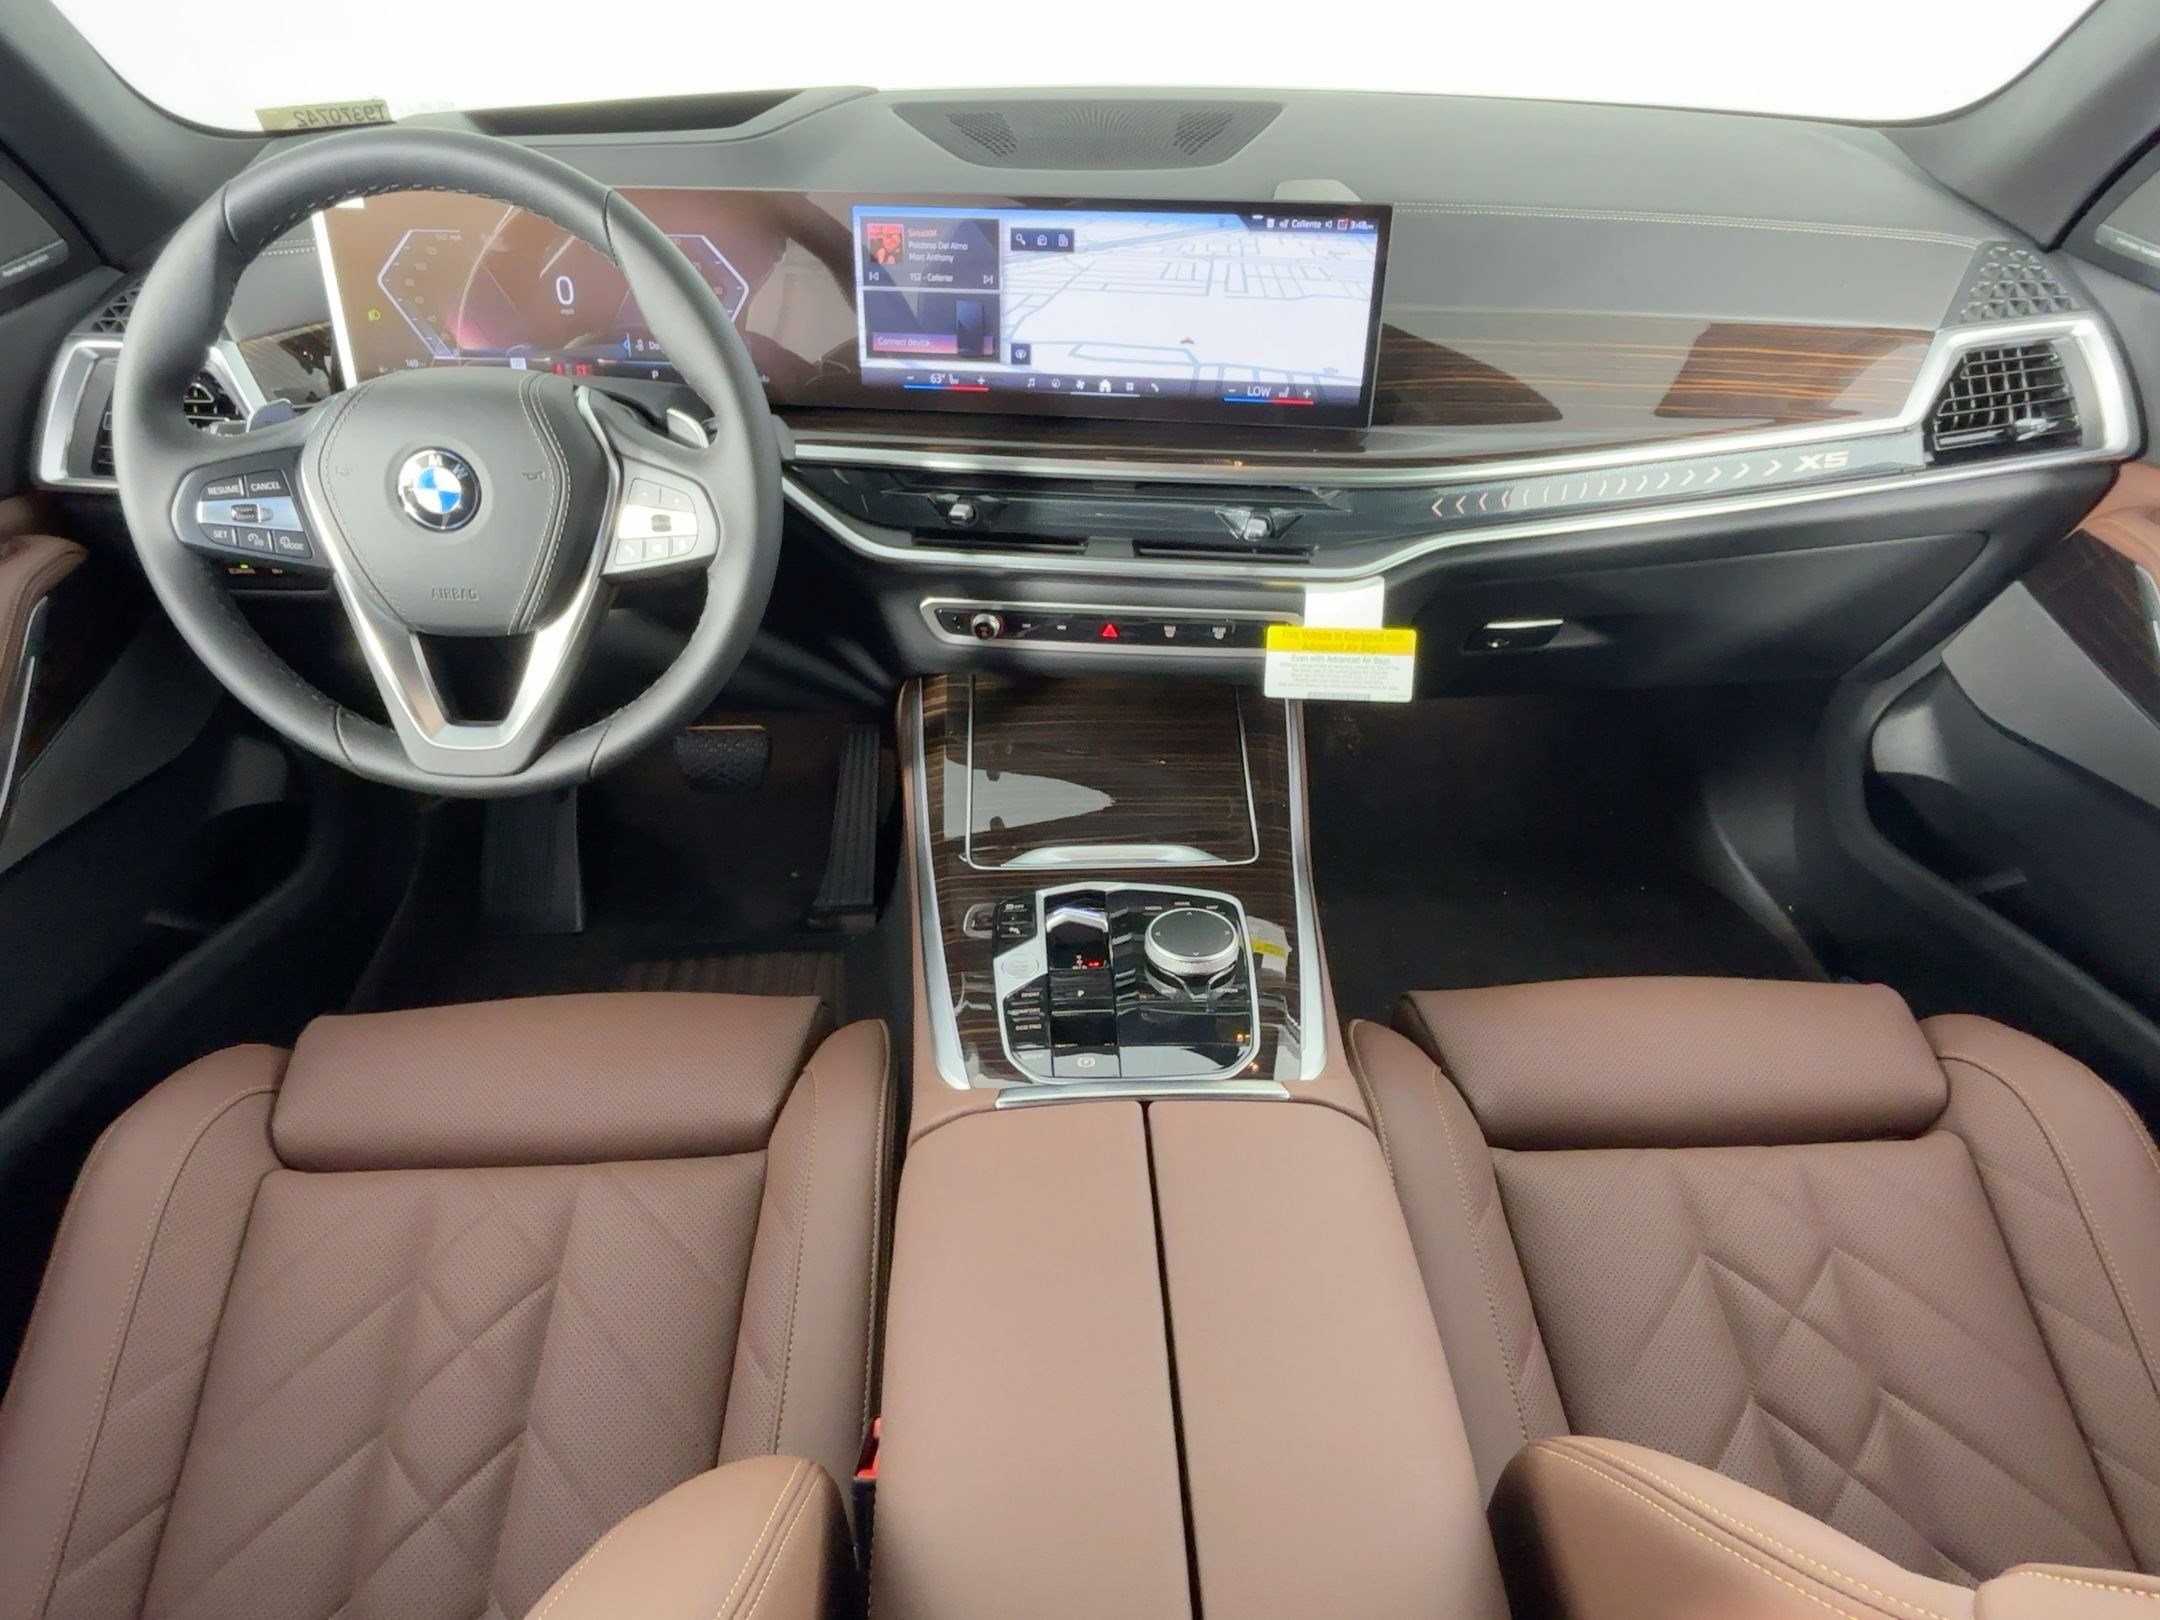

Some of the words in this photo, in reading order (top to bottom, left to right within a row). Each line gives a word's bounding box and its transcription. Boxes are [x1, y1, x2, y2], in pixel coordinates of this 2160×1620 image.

[556, 276, 574, 305] 0
[1248, 386, 1271, 397] LOW
[1792, 450, 1849, 473] X5
[207, 484, 240, 496] RESUME
[250, 480, 281, 492] CANCEL
[213, 530, 228, 539] SET
[431, 587, 478, 600] AIRBAG
